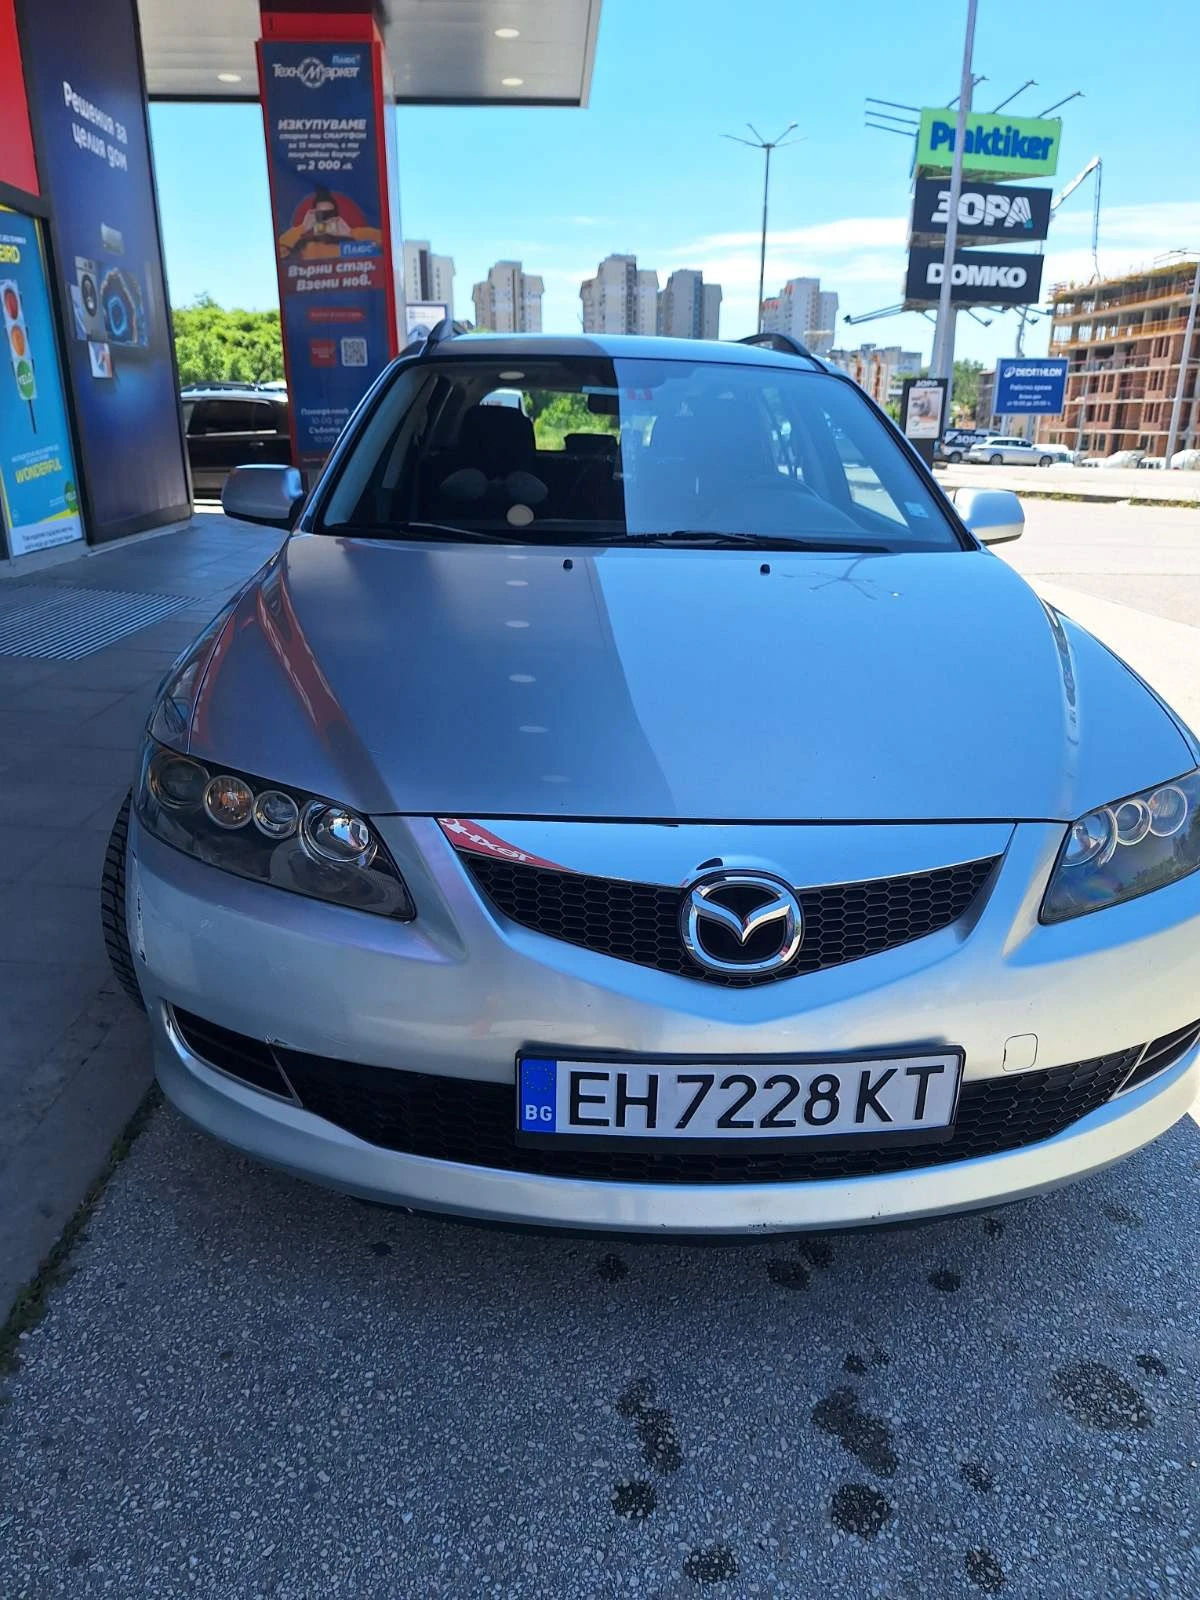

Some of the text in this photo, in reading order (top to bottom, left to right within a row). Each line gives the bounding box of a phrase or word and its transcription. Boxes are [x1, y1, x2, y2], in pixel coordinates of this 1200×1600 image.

[63, 81, 128, 144] Решения за
[278, 119, 366, 130] ИЗКУПУВАМЕ
[72, 122, 106, 158] целия
[930, 120, 1053, 160] Praktiker
[308, 160, 316, 170] 2
[318, 160, 341, 170] 000
[931, 190, 1033, 228] ЗОРА
[288, 265, 333, 278] Върни
[926, 262, 1028, 288] DOMKO
[296, 278, 340, 292] Вземи
[568, 1064, 945, 1130] EH 7228 KT
[525, 1104, 552, 1122] BG
